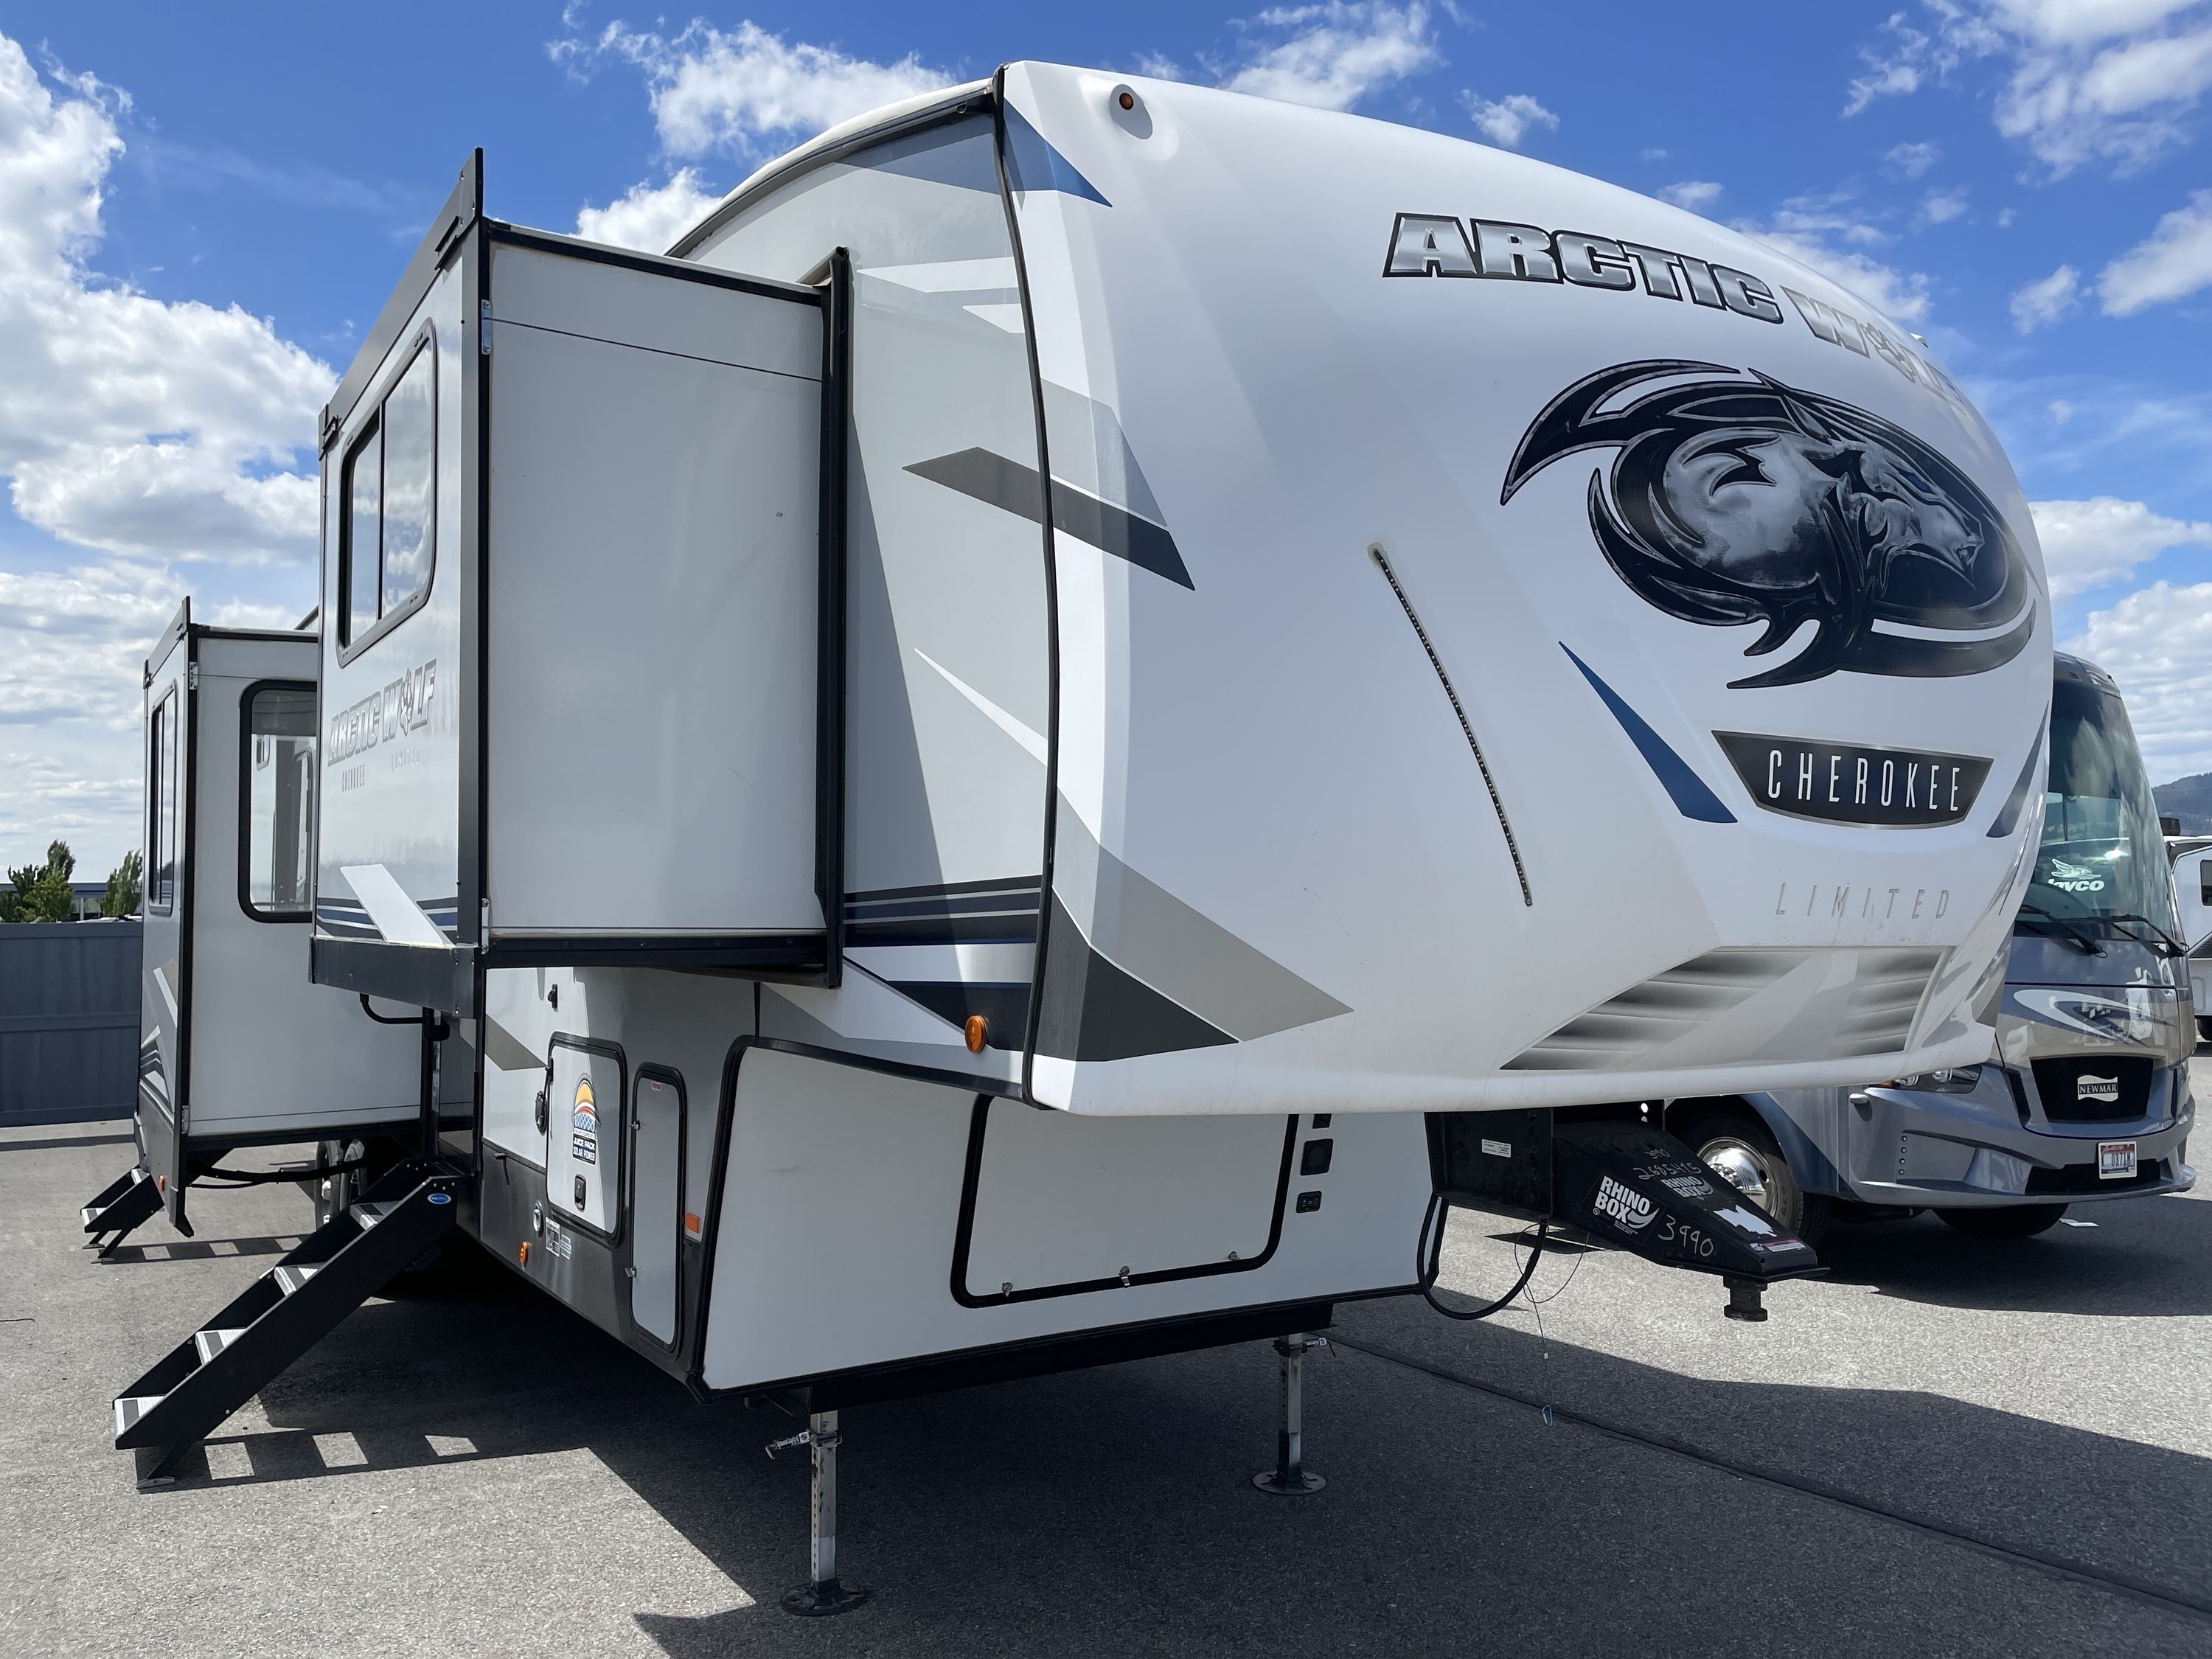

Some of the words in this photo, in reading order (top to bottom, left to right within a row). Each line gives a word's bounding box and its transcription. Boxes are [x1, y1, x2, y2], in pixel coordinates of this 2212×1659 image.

[1382, 211, 1784, 324] ARCTIC
[328, 691, 380, 767] ARCTIC
[1767, 749, 1961, 812] CHEROKEE
[1775, 883, 1950, 919] LIMITED
[2079, 1084, 2118, 1094] NEWMAR
[1599, 1175, 1651, 1215] RHINO
[1660, 1176, 1703, 1189] RHINO
[1672, 1186, 1707, 1198] BOX
[1594, 1191, 1632, 1224] BOX
[1658, 1214, 1714, 1257] 3990
